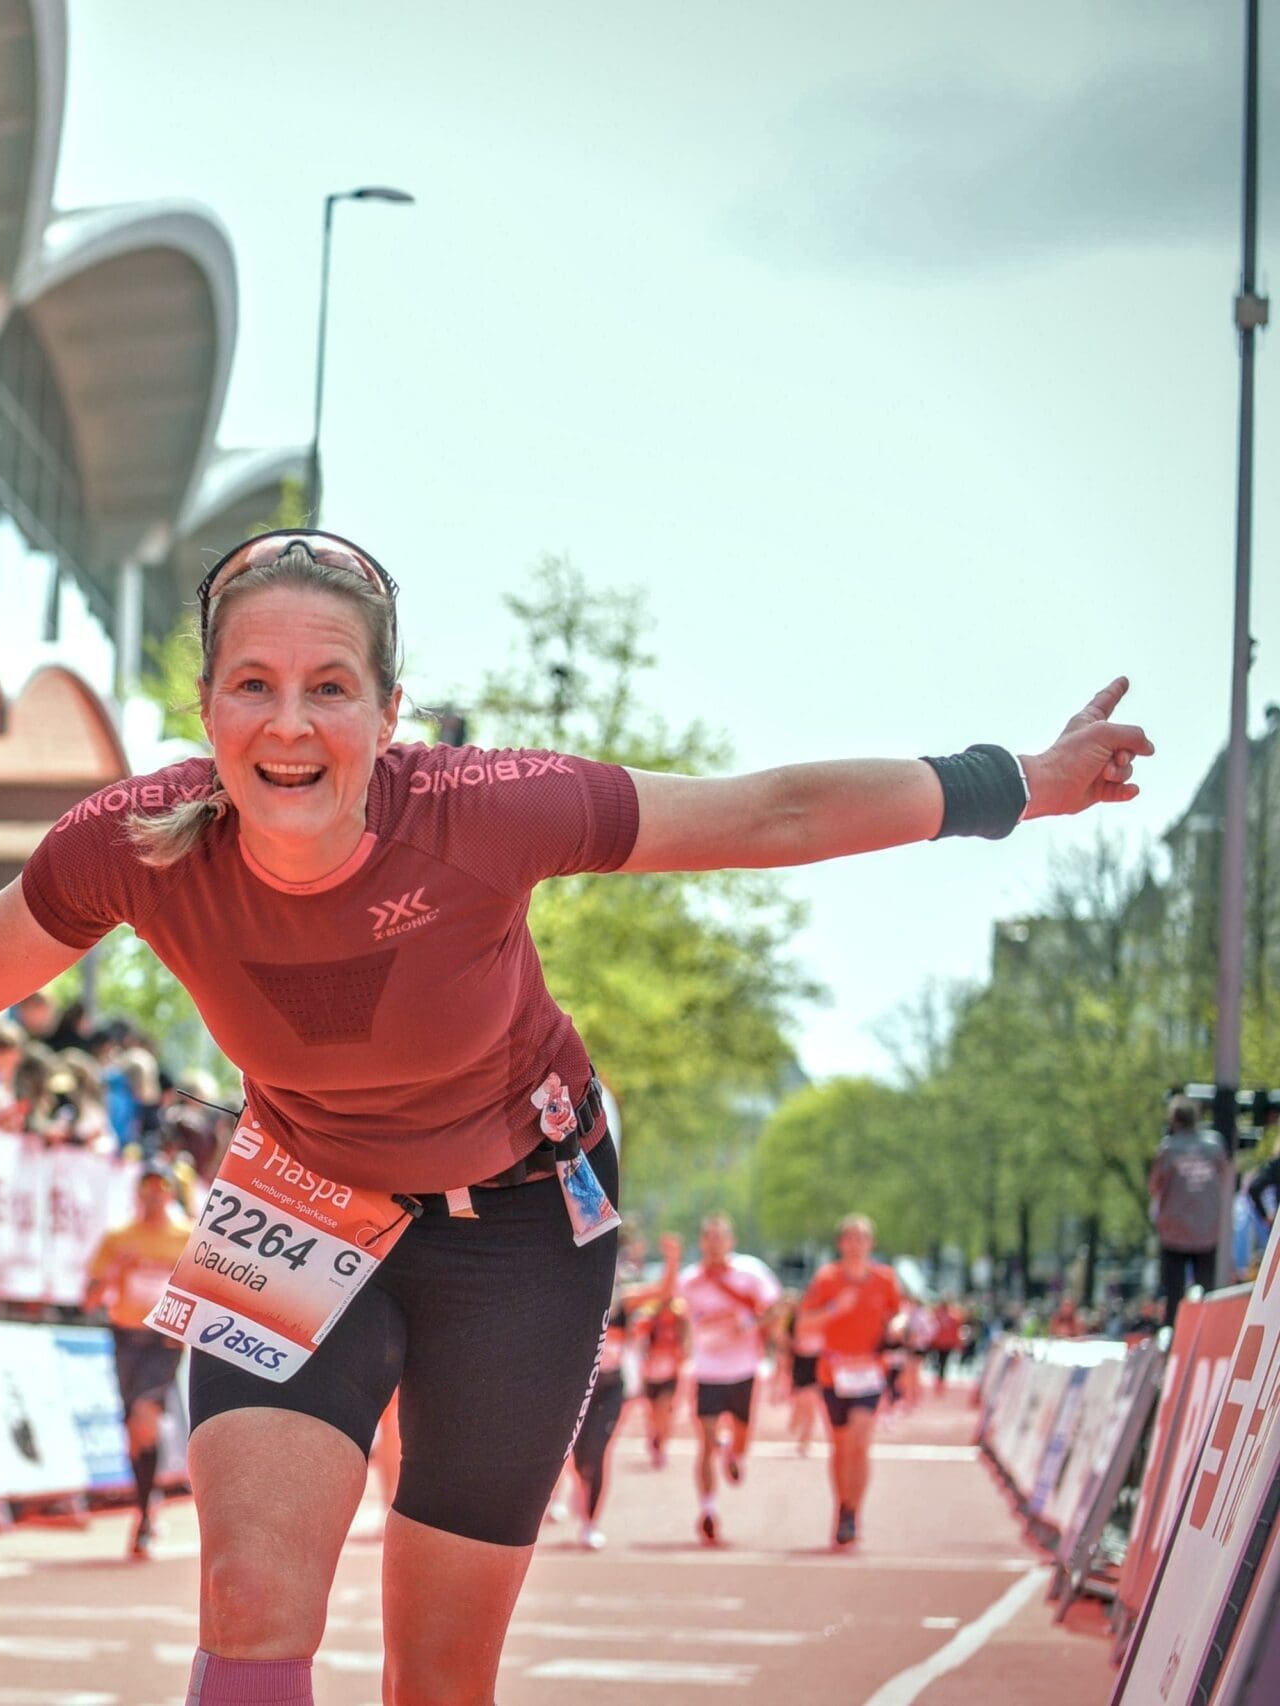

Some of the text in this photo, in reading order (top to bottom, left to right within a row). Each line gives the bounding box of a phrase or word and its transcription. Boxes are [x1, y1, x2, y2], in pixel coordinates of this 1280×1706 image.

[263, 1143, 353, 1210] Haspa
[250, 1177, 339, 1229] Hamburger Sparkasse
[198, 1188, 318, 1271] F2264
[194, 1240, 268, 1292] Claudia
[333, 1250, 362, 1277] G
[223, 1329, 289, 1369] asics
